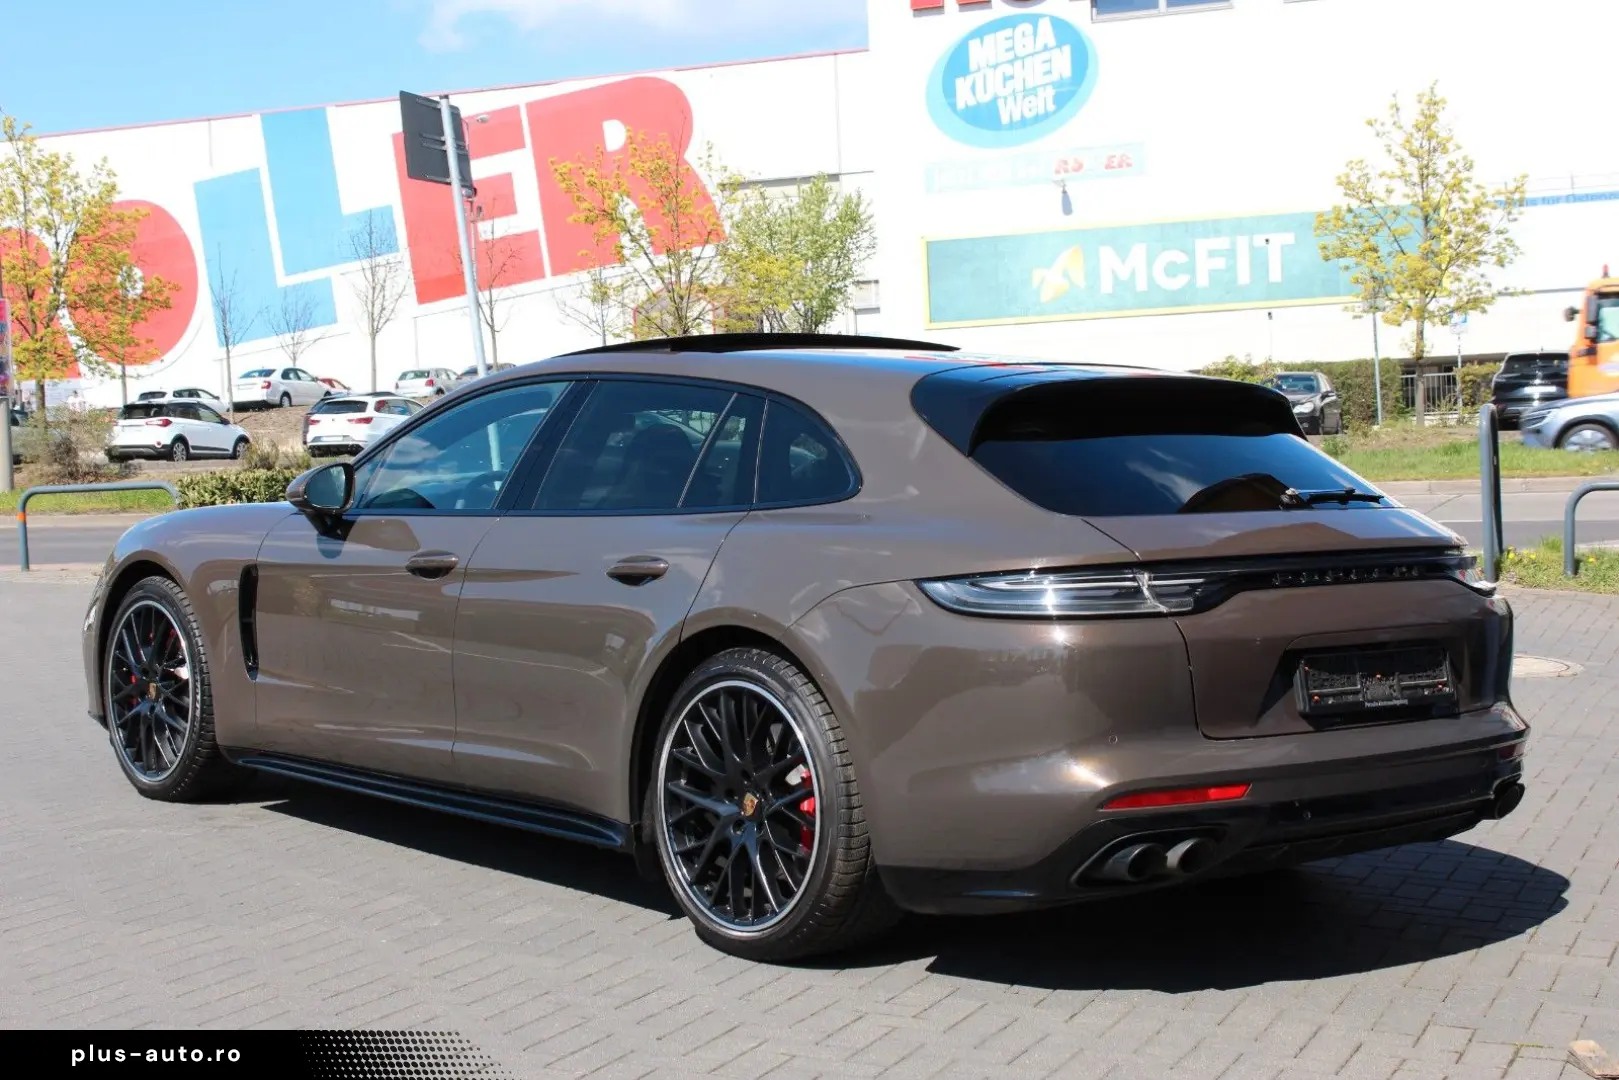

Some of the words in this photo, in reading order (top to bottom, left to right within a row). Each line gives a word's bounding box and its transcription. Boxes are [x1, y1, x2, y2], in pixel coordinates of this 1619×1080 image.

[968, 16, 1056, 71] MEGA
[996, 86, 1056, 125] Welt
[0, 76, 726, 380] OLLER
[1099, 232, 1295, 294] McFIT
